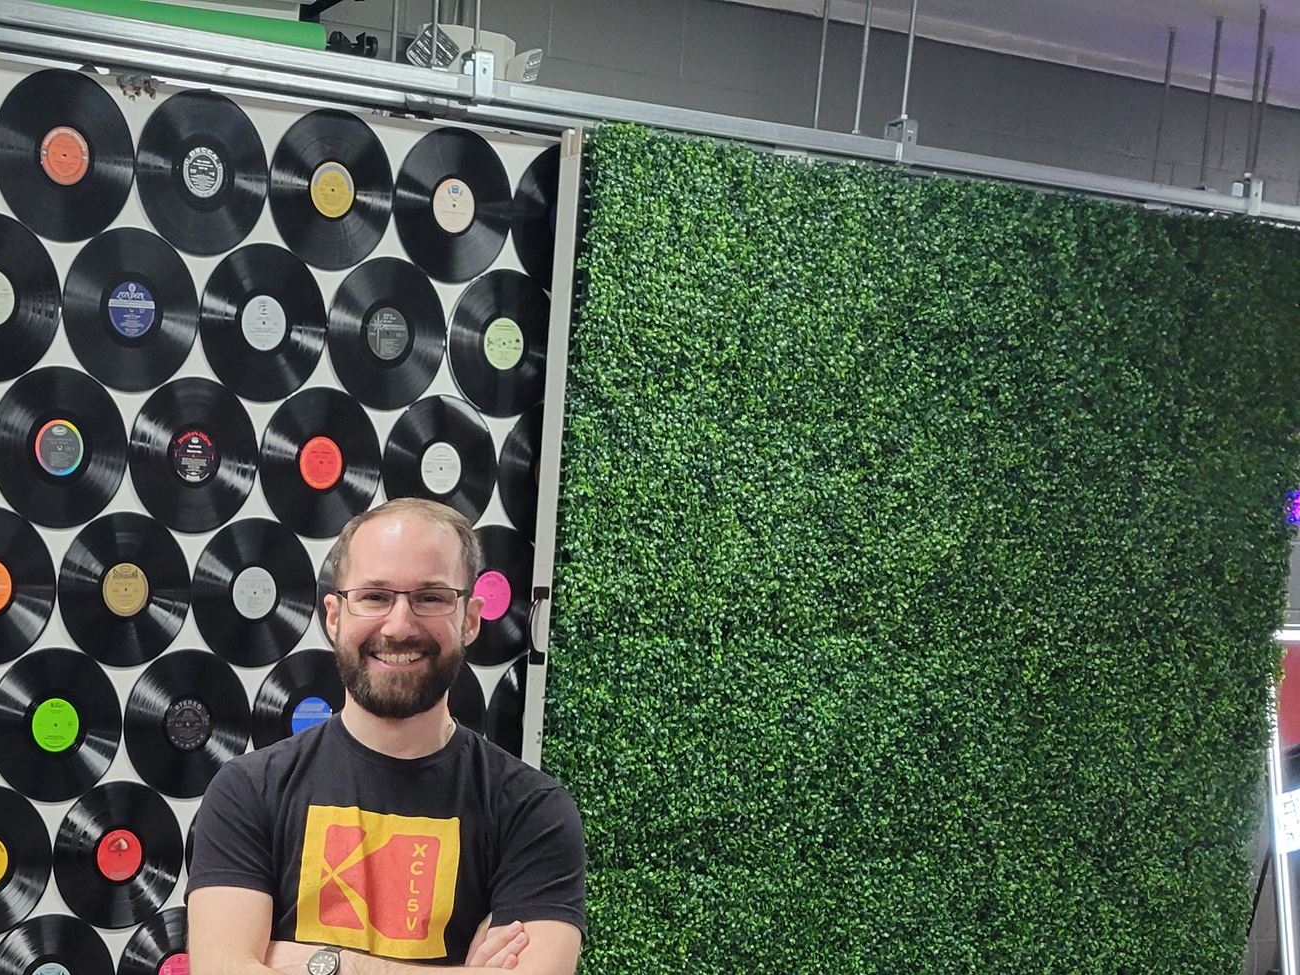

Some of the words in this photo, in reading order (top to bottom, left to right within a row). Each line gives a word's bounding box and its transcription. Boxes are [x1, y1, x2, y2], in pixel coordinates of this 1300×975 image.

[189, 147, 218, 162] DECCA
[116, 290, 145, 301] LONDON
[175, 700, 202, 711] STEREO
[406, 843, 428, 932] XCLSV
